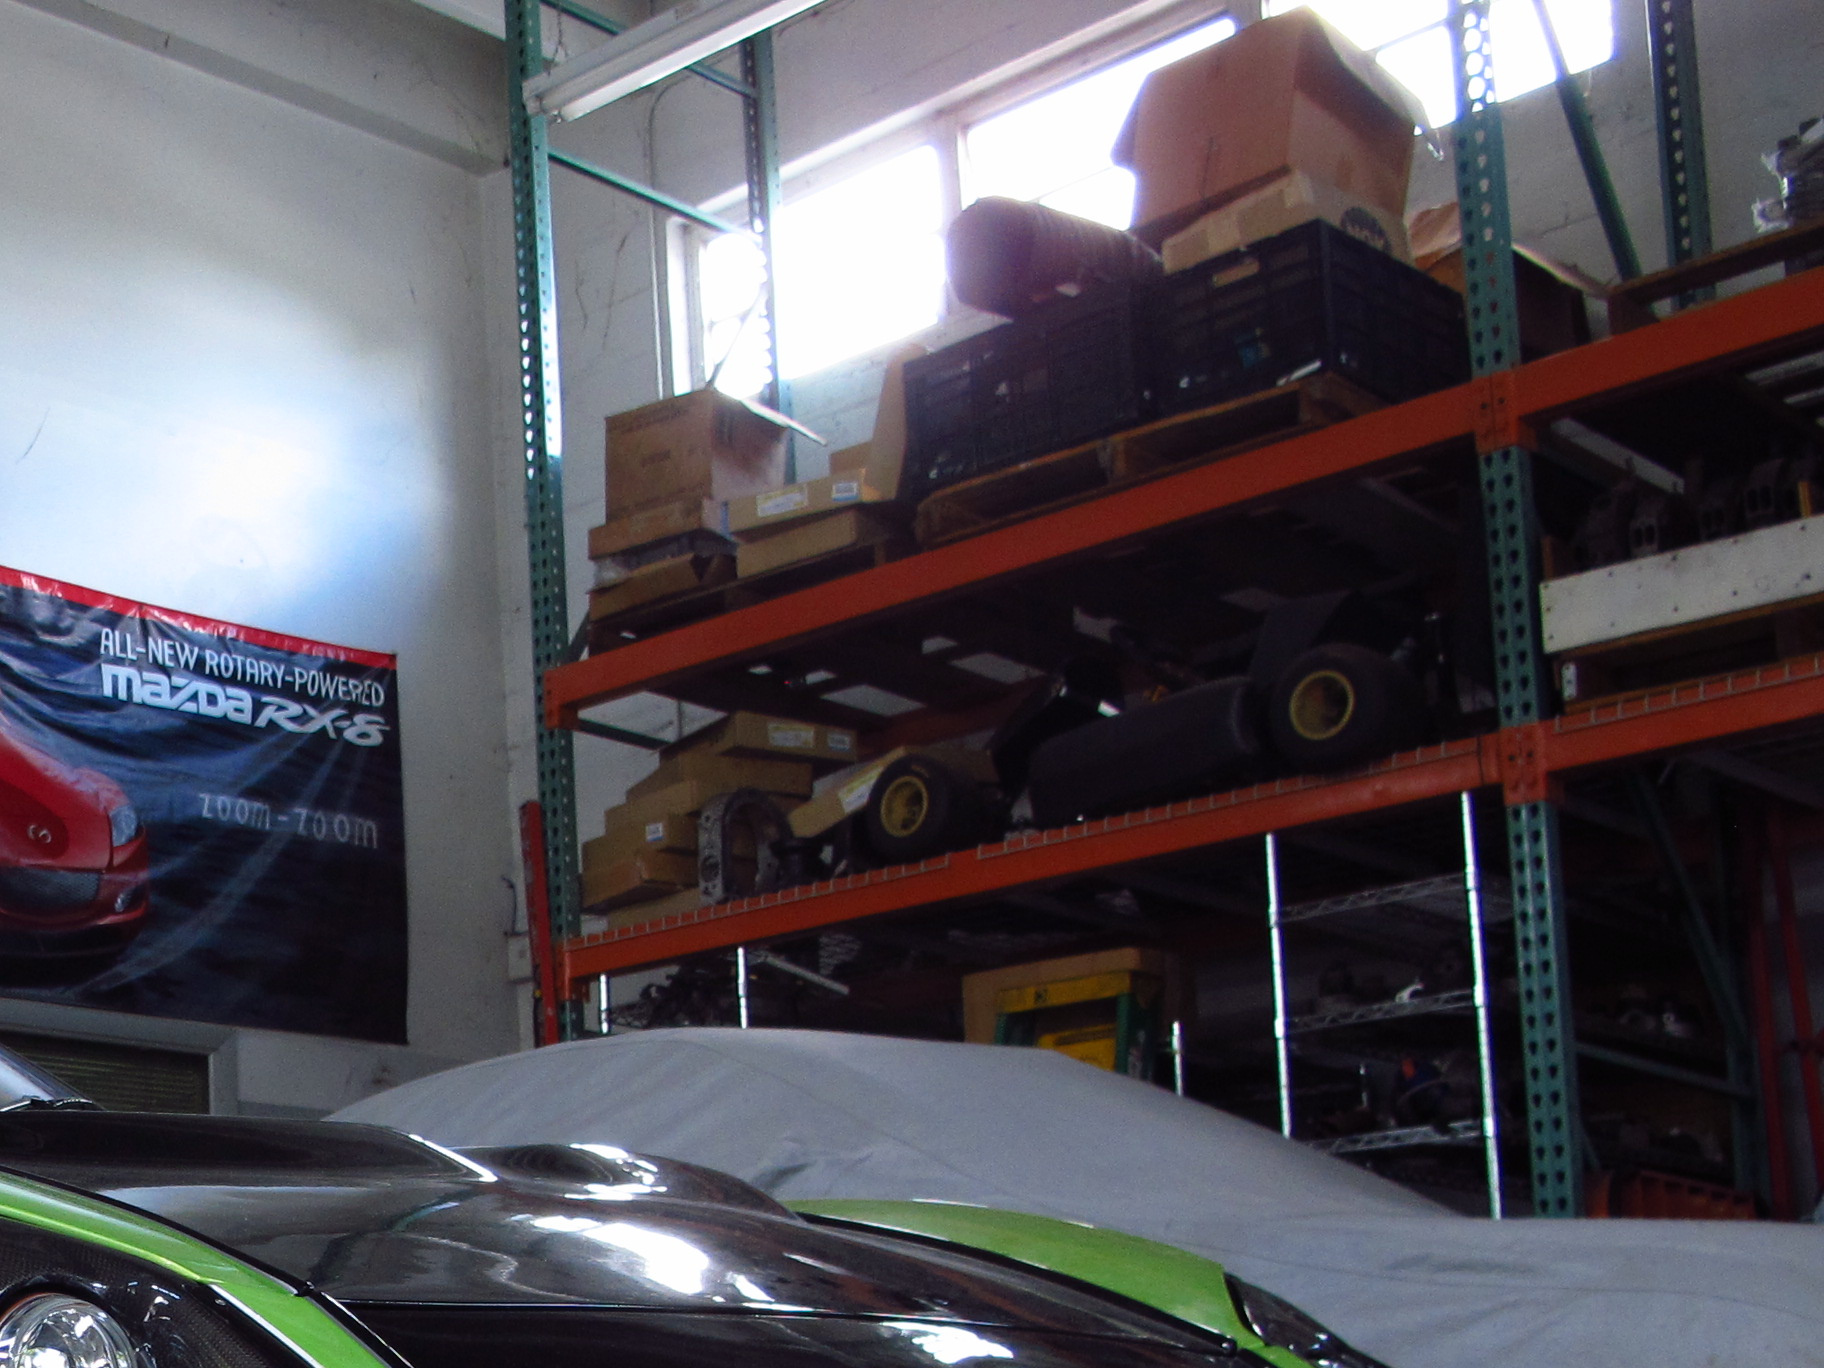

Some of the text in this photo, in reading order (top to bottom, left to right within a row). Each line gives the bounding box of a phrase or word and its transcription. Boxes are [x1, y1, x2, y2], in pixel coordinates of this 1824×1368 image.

[101, 628, 385, 708] ALL-NEW ROTARY-POWERED
[253, 696, 391, 747] RX-8
